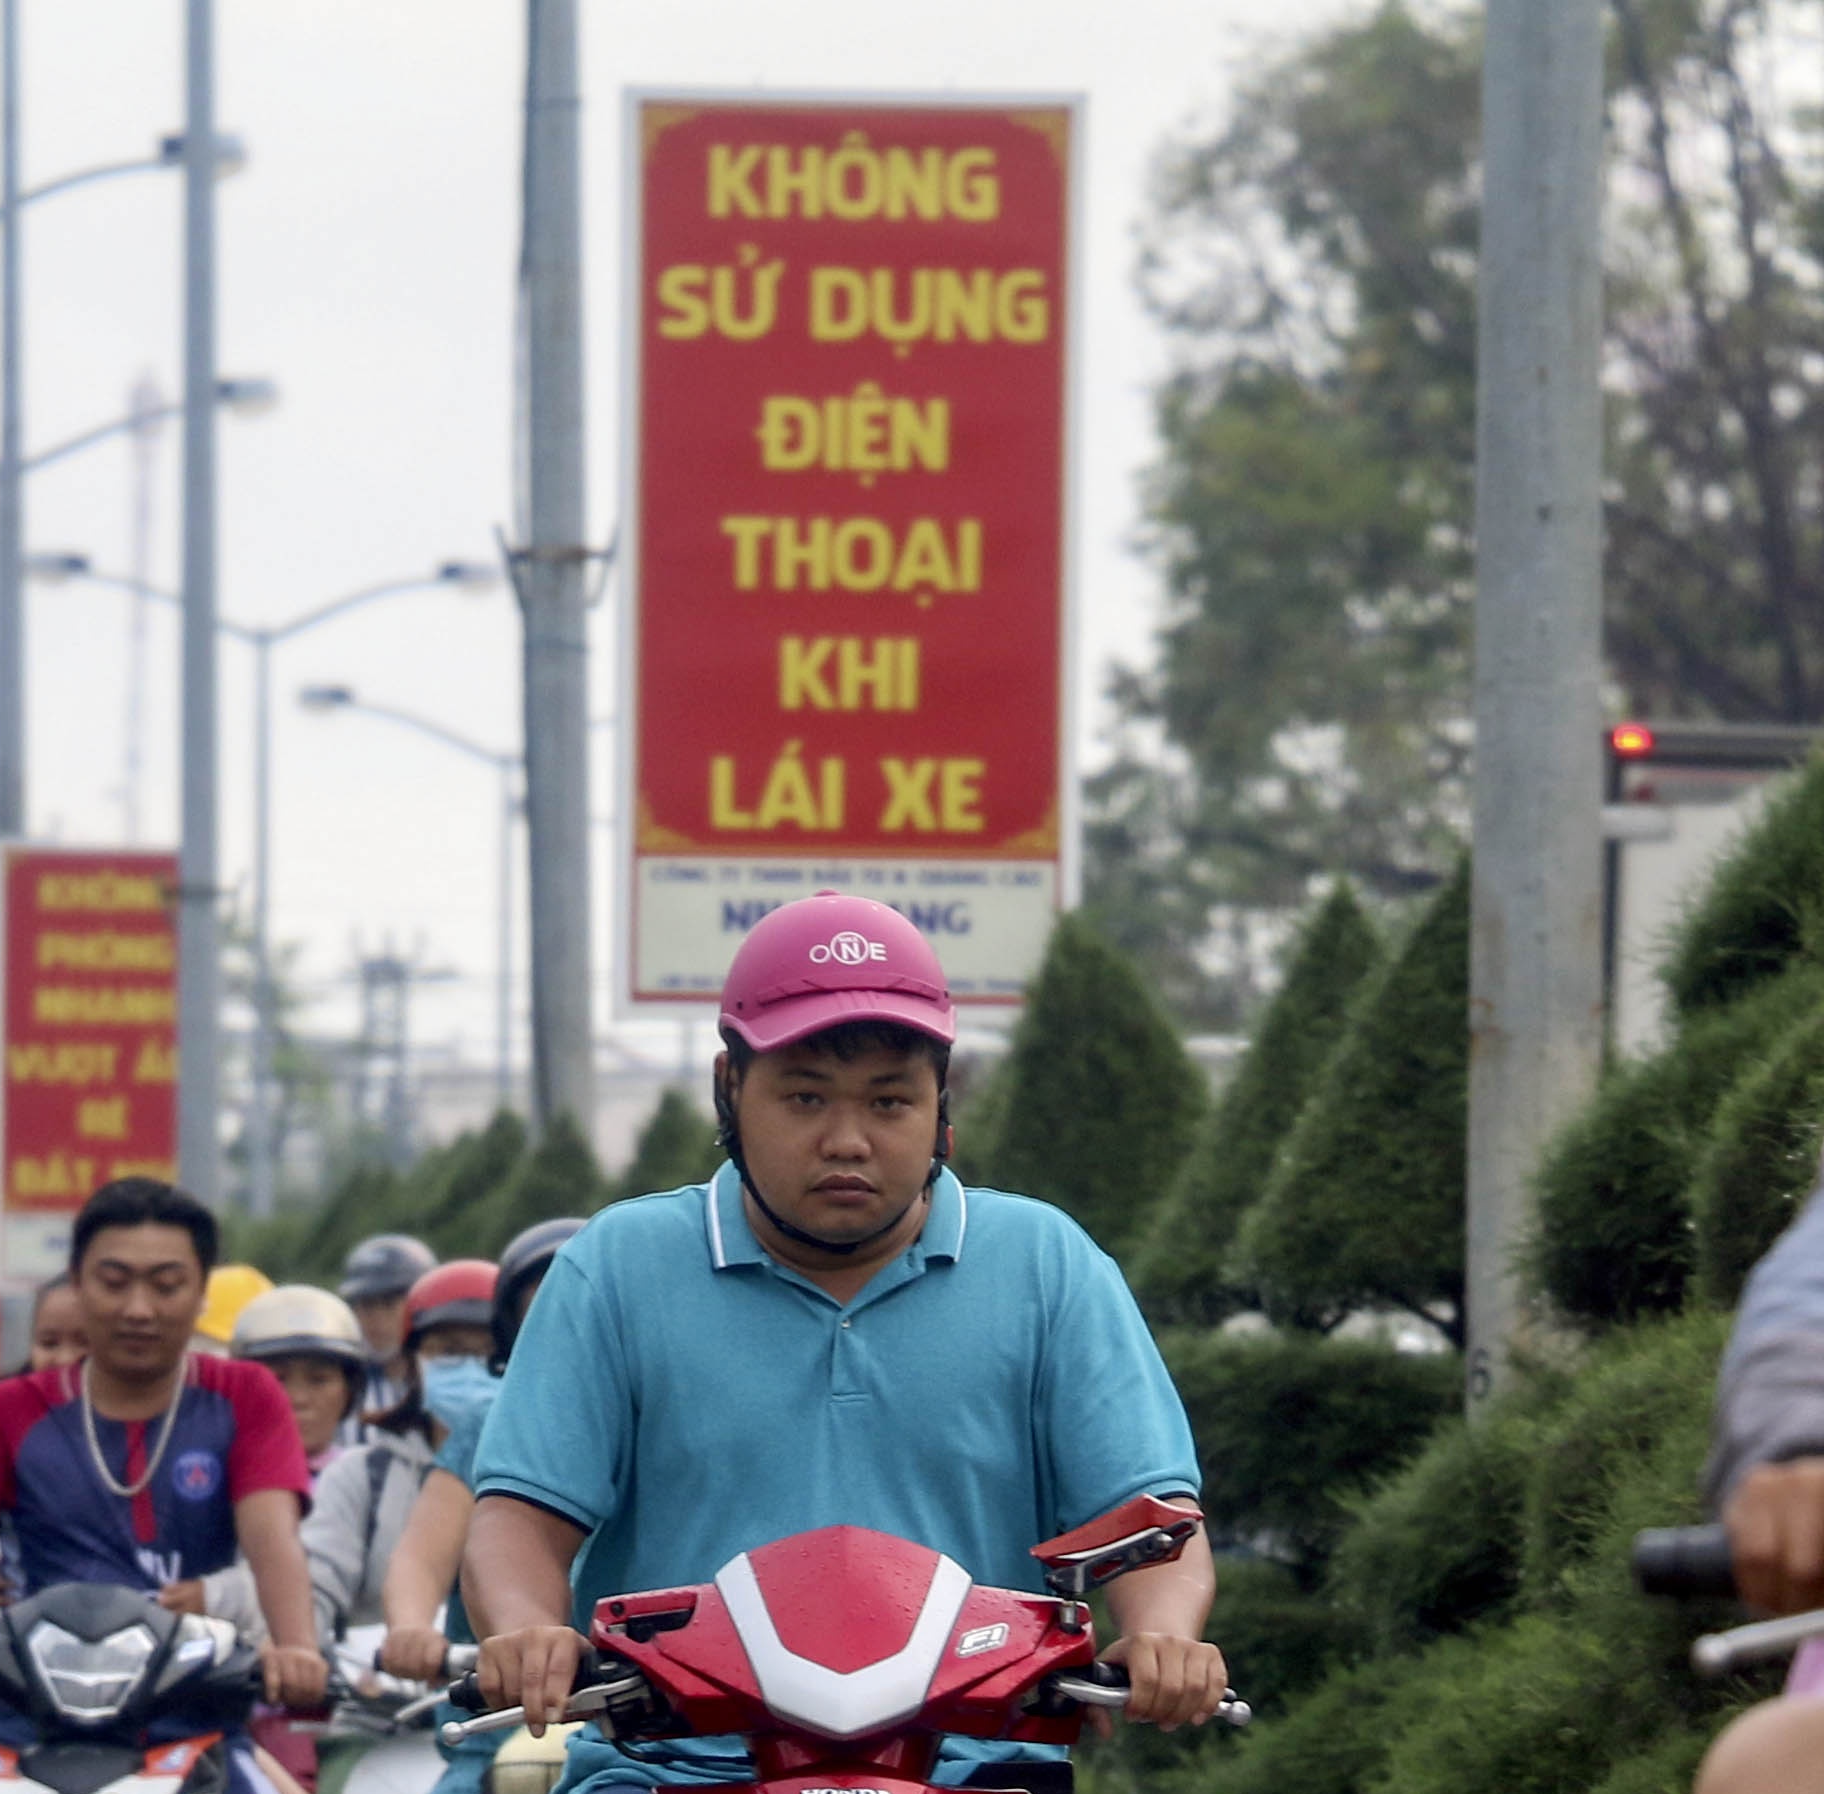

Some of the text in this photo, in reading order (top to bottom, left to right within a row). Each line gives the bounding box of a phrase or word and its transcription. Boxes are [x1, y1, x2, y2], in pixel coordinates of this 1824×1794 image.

[707, 131, 1000, 222] KHÔNG
[657, 244, 1050, 357] SỬ DỤNG
[756, 383, 950, 486] ĐIỆN
[722, 515, 983, 606] THOẠI
[778, 637, 921, 711] KHI
[709, 741, 986, 832] LÁI XE
